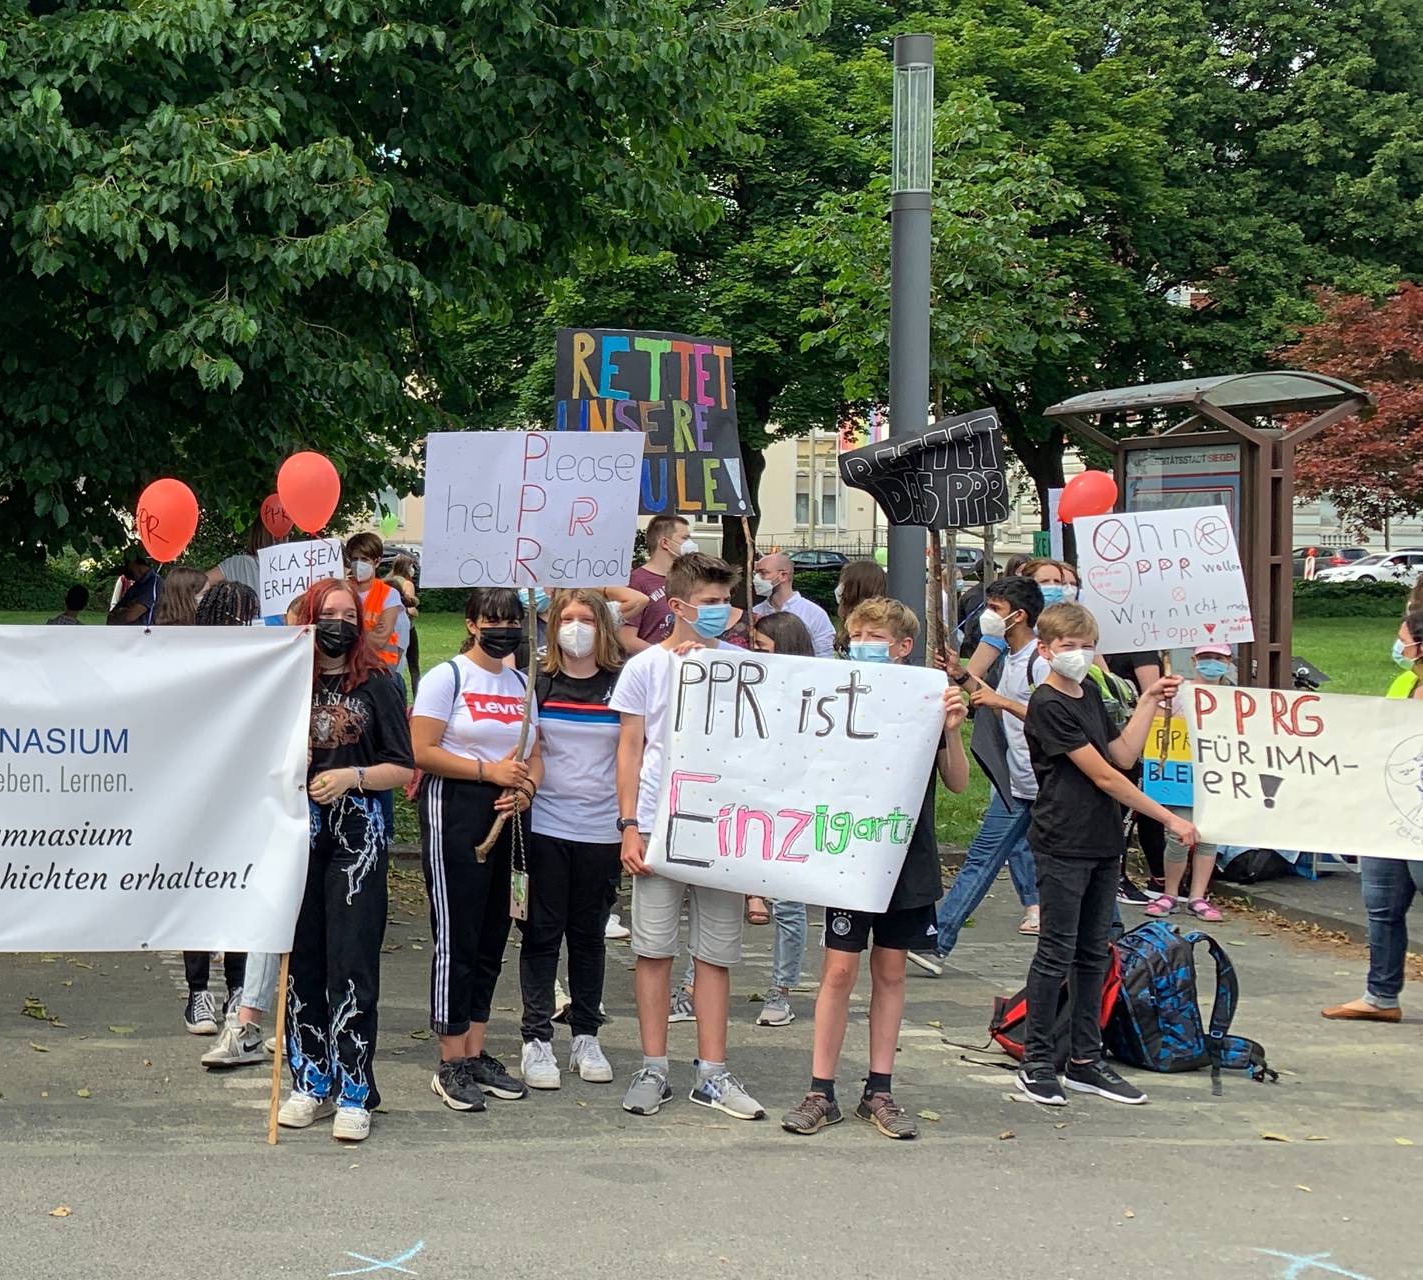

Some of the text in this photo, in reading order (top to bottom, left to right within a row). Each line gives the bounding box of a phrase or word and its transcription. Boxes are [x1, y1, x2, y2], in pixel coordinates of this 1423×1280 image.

[571, 332, 733, 410] RETTET
[557, 400, 714, 453] UNSERE
[523, 432, 636, 482] Please
[641, 458, 747, 511] ULE!
[947, 470, 1008, 527] PPR
[139, 508, 169, 544] PR
[269, 545, 342, 573] KLASSEN
[549, 549, 628, 580] school
[1136, 557, 1193, 587] PPR
[675, 660, 879, 740] PPR ist
[1197, 735, 1256, 765] FÜR
[60, 765, 134, 793] Lernen.
[1148, 762, 1194, 783] BLEI
[119, 861, 253, 891] erhalten!
